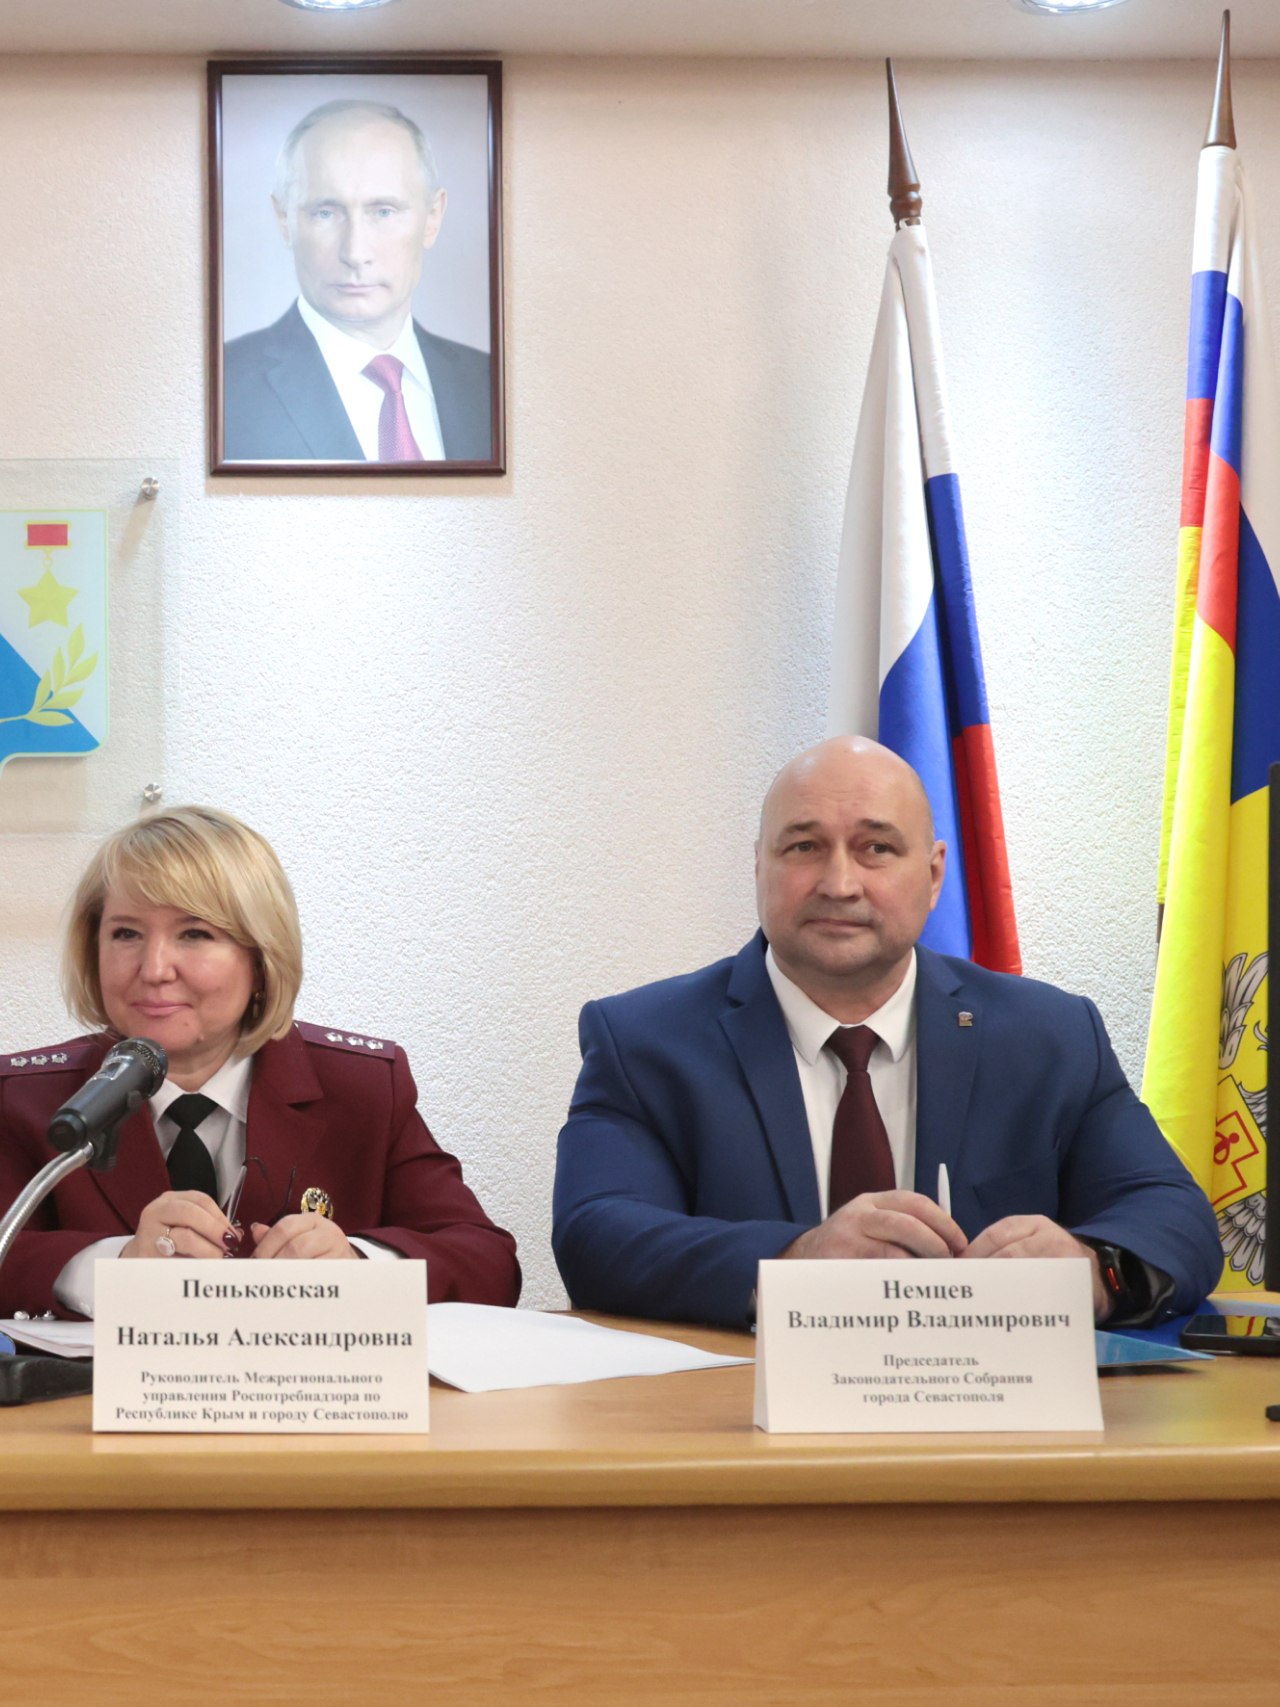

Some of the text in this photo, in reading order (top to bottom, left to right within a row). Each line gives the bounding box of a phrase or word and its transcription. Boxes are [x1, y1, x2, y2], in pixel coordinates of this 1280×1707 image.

[181, 1278, 340, 1300] Пеньковская
[882, 1279, 974, 1301] Немцев
[787, 1309, 1071, 1334] Владимир Владимирович
[116, 1325, 413, 1353] Наталья Александровна
[883, 1353, 980, 1370] Председатель
[140, 1370, 383, 1388] Руководитель Межрегионального
[832, 1371, 1033, 1388] Законодательного Собрания
[142, 1389, 381, 1405] управления Роспотребнадзора по
[862, 1390, 1005, 1407] города Севастополя
[115, 1406, 409, 1424] Республике Крым и городу Севастополю
